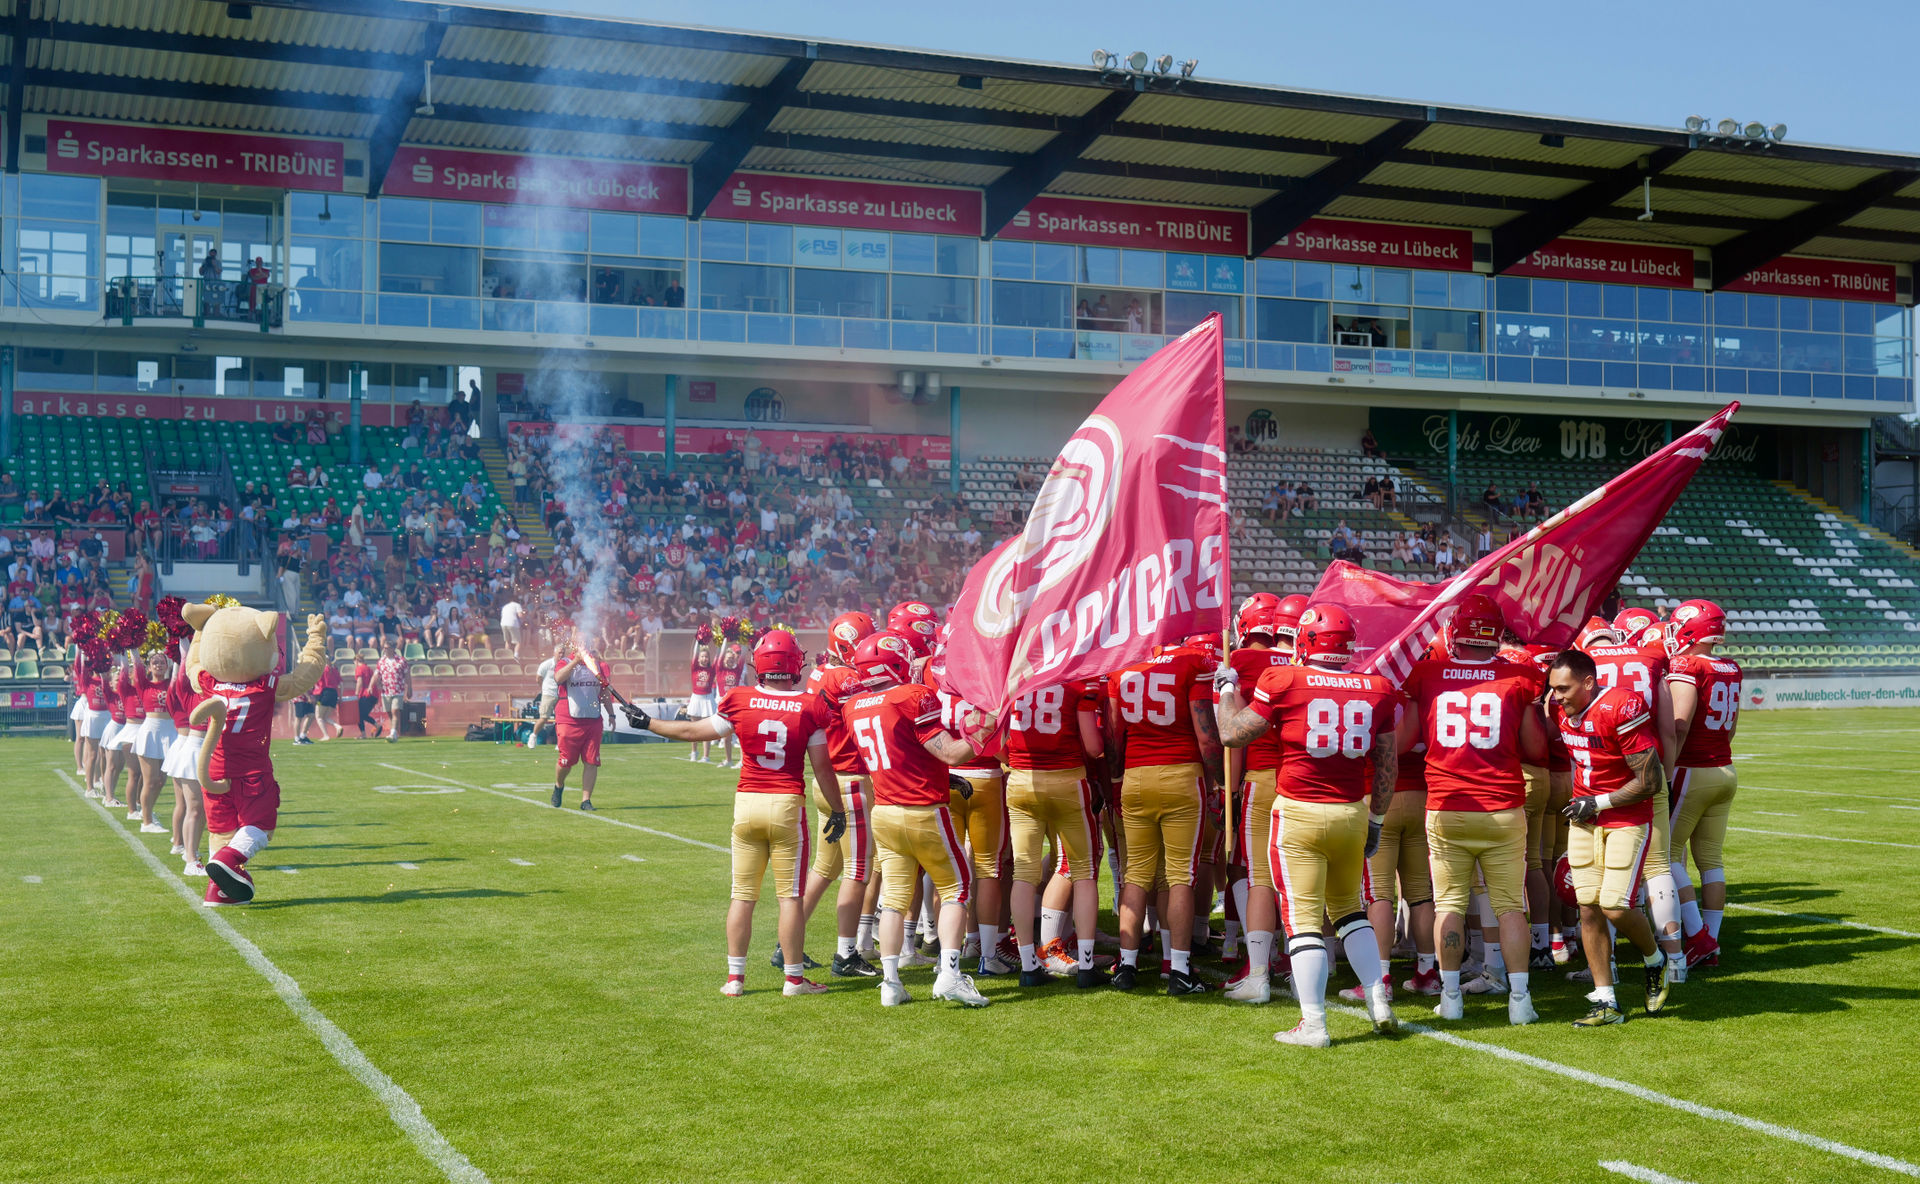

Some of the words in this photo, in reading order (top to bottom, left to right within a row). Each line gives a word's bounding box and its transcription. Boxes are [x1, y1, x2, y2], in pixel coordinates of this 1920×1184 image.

[87, 141, 218, 169] Sparkassen
[240, 152, 337, 177] TRIBÜNE
[443, 167, 548, 191] Sparkasse
[553, 179, 580, 196] zu
[587, 178, 660, 200] Lübeck
[760, 190, 859, 215] Sparkasse
[863, 202, 885, 217] zu
[891, 200, 957, 222] Lübeck
[1038, 212, 1140, 235] Sparkassen
[1156, 220, 1232, 242] TRIBÜNE
[1295, 232, 1376, 253] Sparkasse
[1381, 242, 1399, 254] zu
[1404, 240, 1459, 259] Lübeck
[1532, 250, 1607, 272] Sparkasse
[1610, 260, 1627, 273] zu
[1631, 258, 1681, 276] Lübeck
[1744, 270, 1820, 288] Sparkassen
[1834, 273, 1890, 292] TRIBÜNE
[22, 396, 147, 417] arkasse
[184, 406, 215, 420] zu
[255, 404, 343, 424] Lübec
[1560, 419, 1607, 459] VfB
[1034, 535, 1223, 675] COUGRS
[1590, 648, 1638, 656] COUGARS
[1306, 674, 1362, 689] COUGARS
[1363, 679, 1372, 690] II
[1442, 668, 1496, 680] COUGARS
[1596, 662, 1652, 708] 73
[212, 694, 250, 734] 7
[750, 698, 802, 712] COUGARS
[1120, 670, 1176, 726] 95
[1306, 698, 1372, 760] 88
[1436, 691, 1502, 750] 69
[756, 719, 788, 770] 3
[854, 715, 892, 772] 51
[1572, 749, 1593, 788] 7
